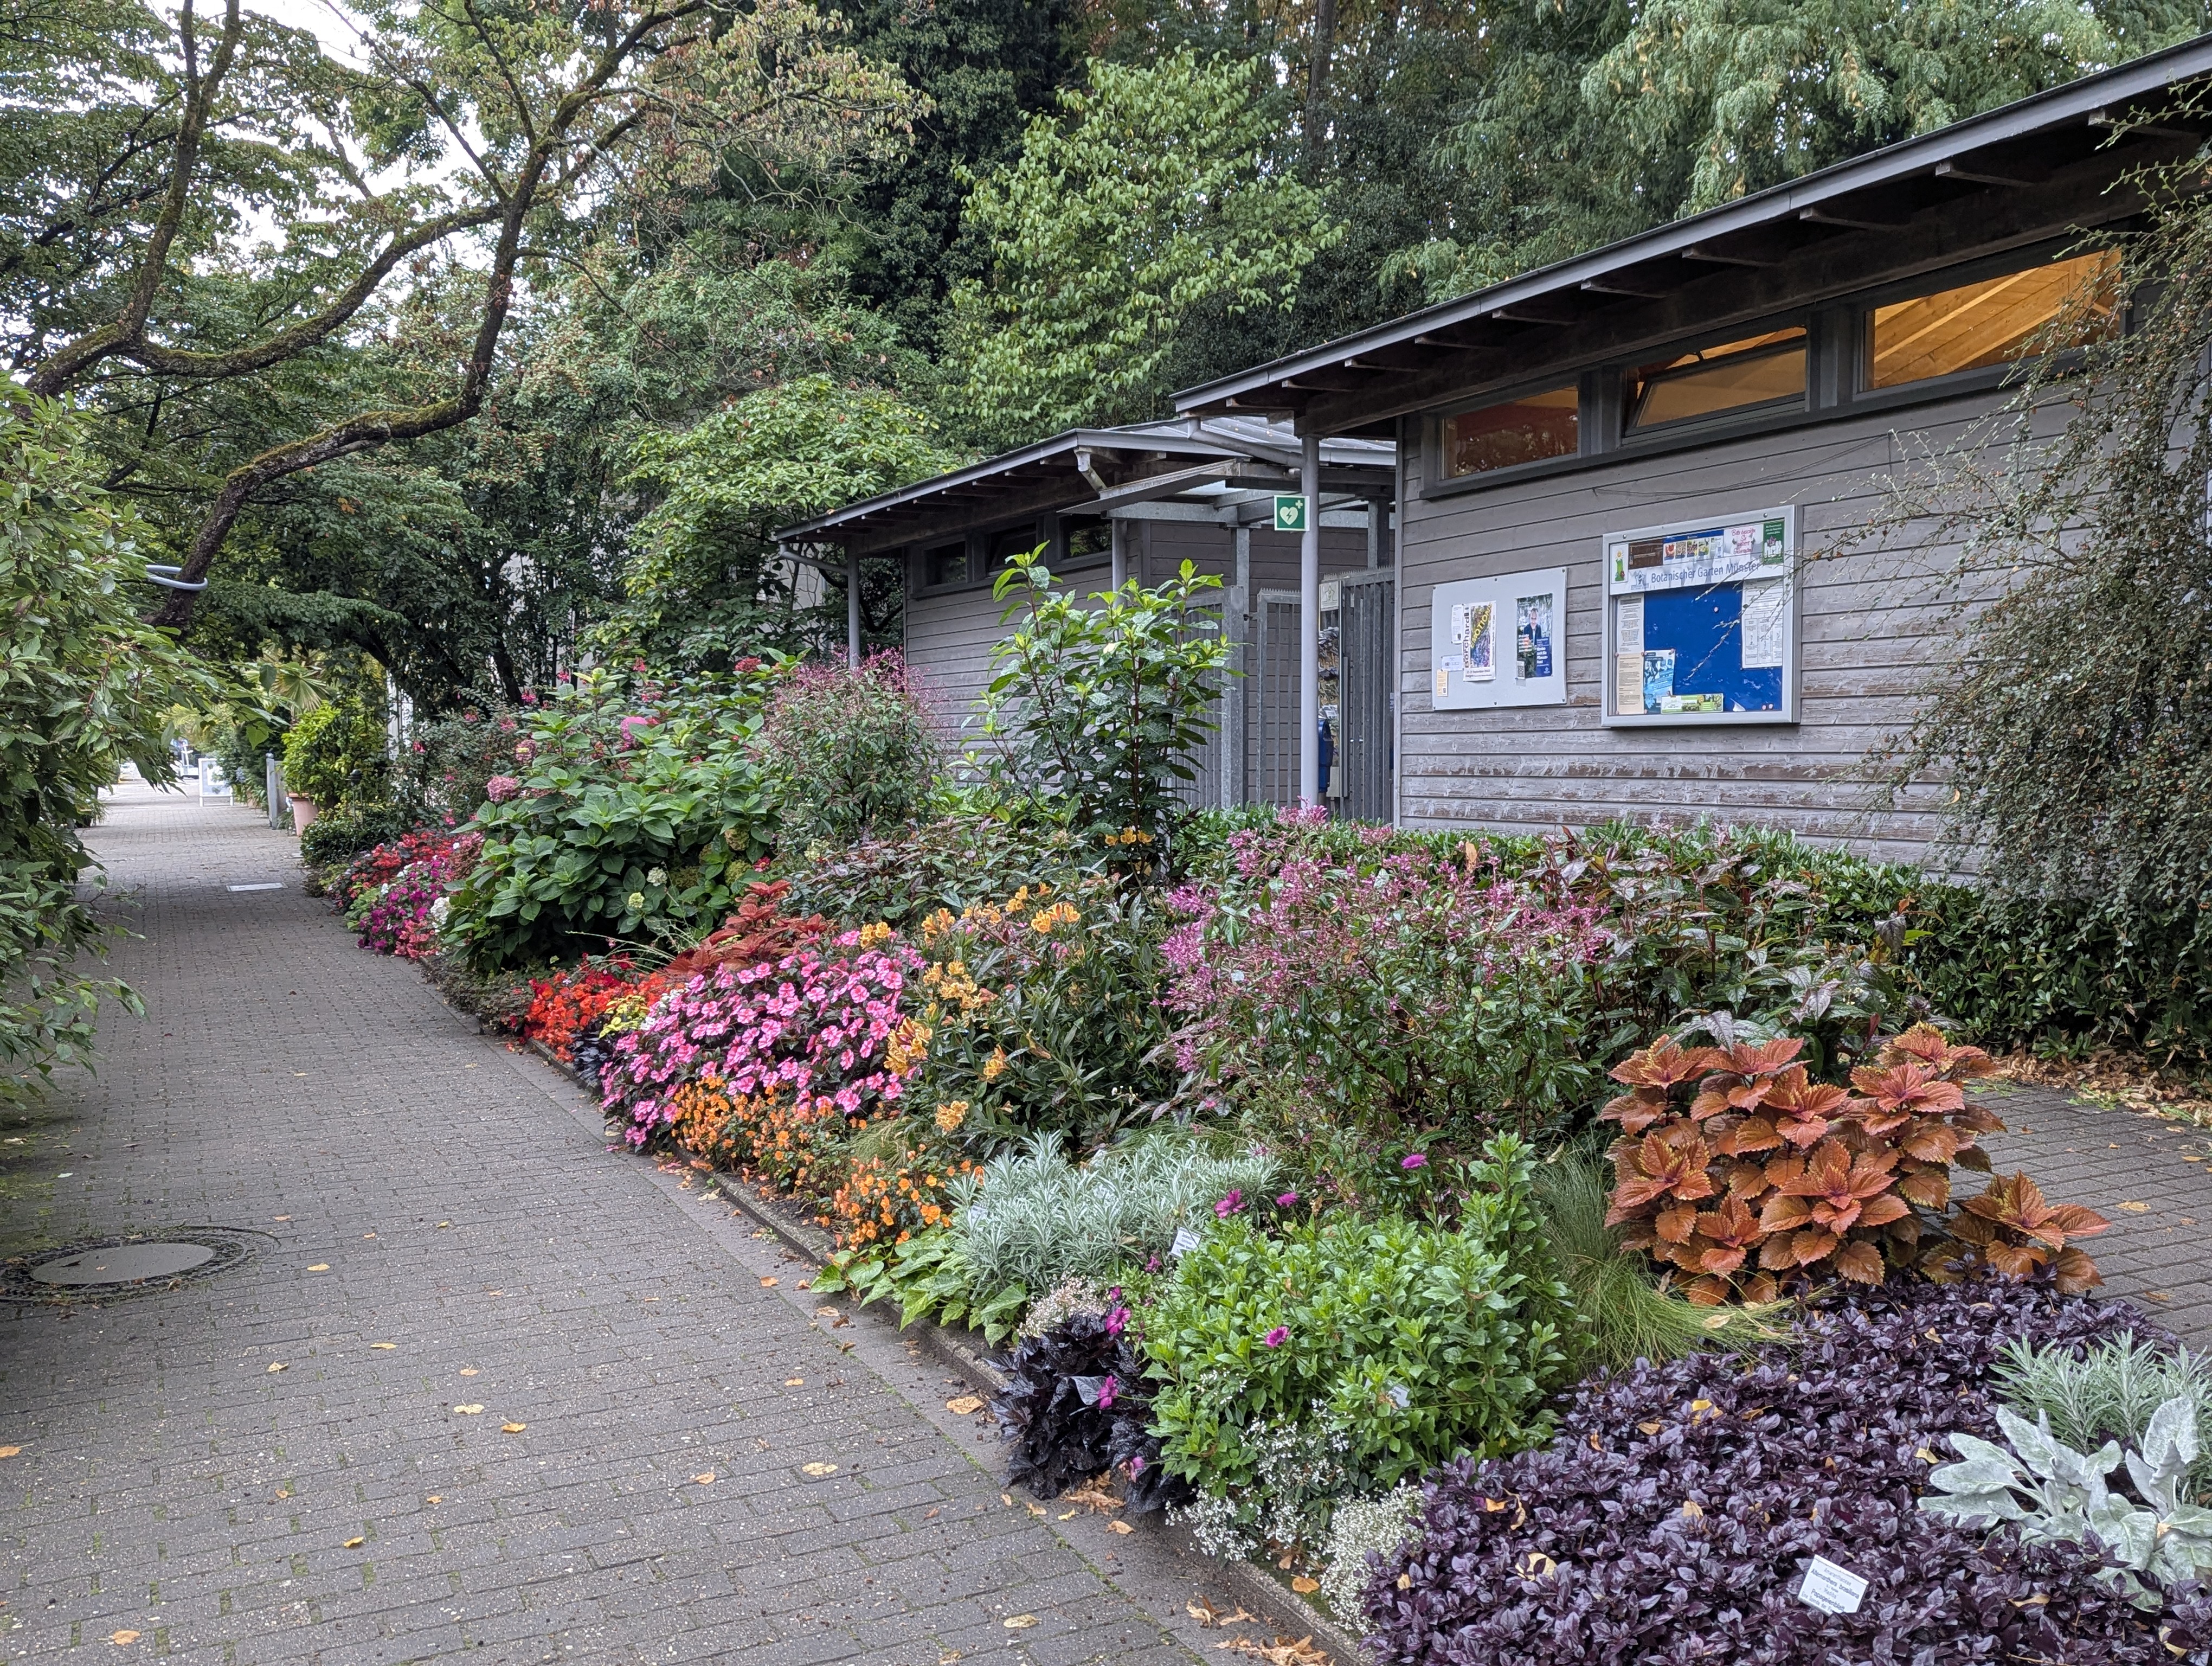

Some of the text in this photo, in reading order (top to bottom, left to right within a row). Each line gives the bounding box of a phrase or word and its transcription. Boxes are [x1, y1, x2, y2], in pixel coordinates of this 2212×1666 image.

[1651, 562, 1759, 583] Botanischer Garten Münster
[1811, 1568, 1859, 1599] Alternanthera brasiliana
